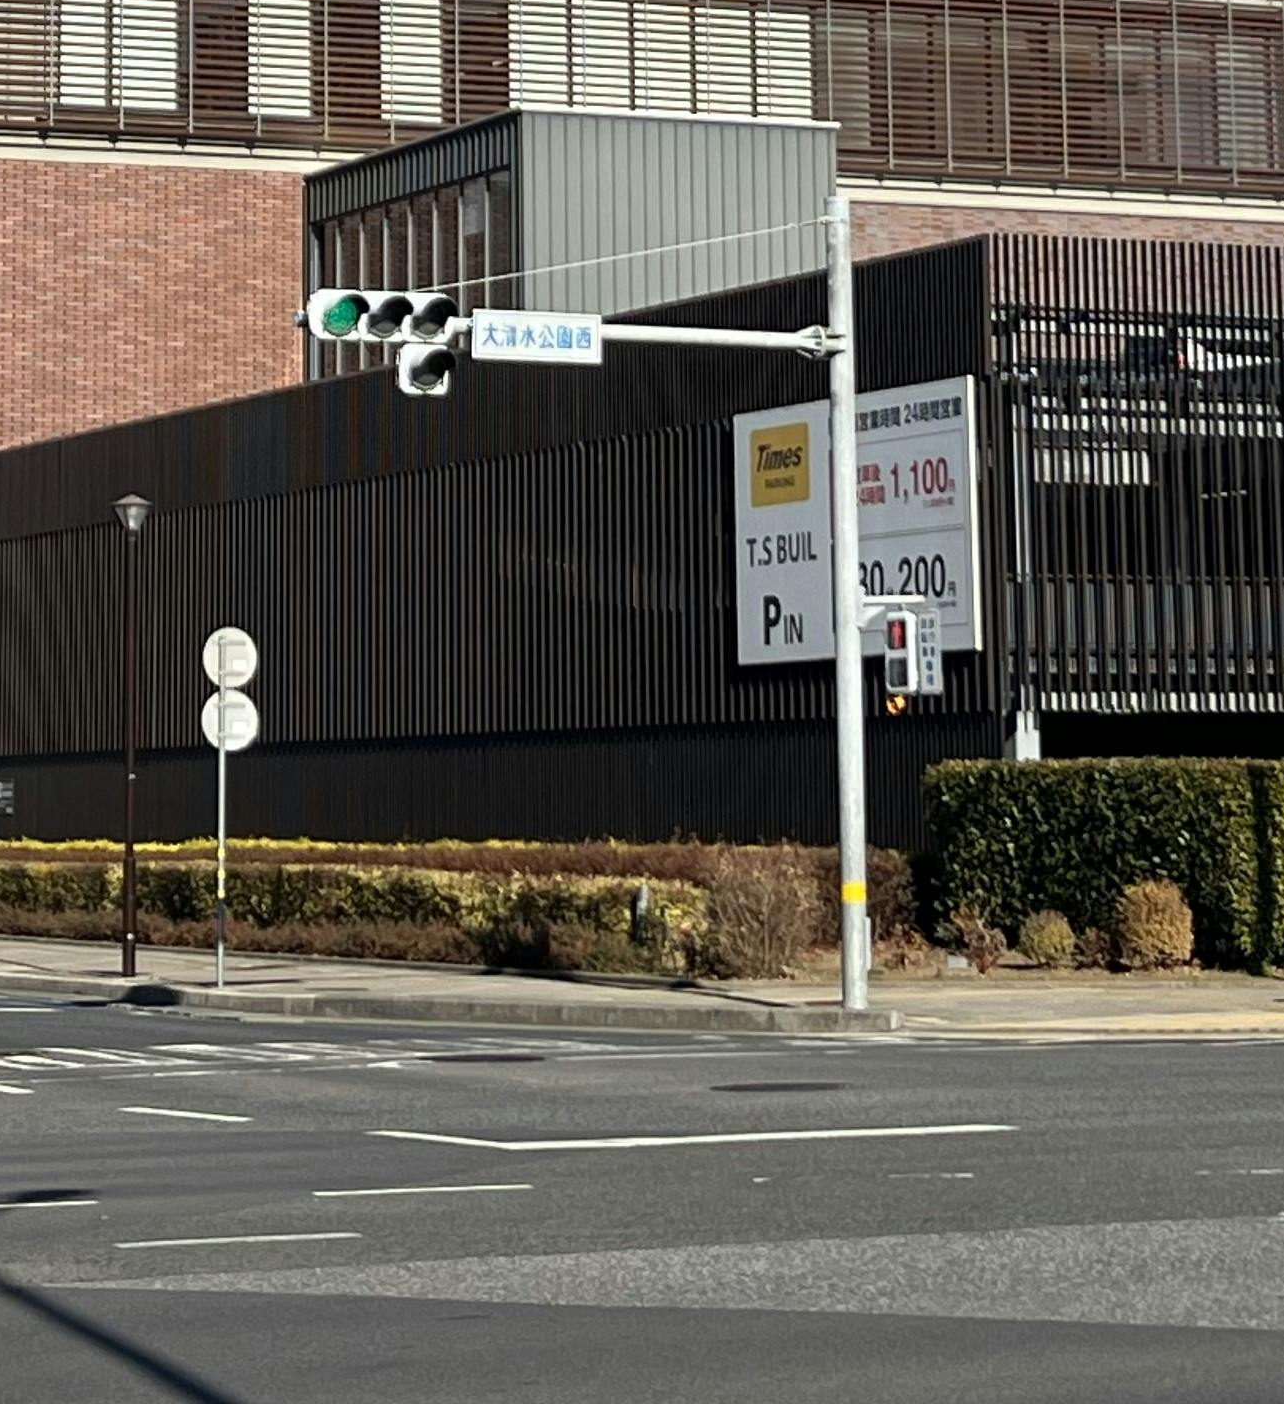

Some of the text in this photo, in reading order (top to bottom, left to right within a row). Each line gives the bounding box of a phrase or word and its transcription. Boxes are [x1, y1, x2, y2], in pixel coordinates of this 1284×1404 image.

[481, 321, 592, 350] 大清水公園西
[756, 443, 803, 473] Times
[746, 531, 818, 567] T.S BUIL
